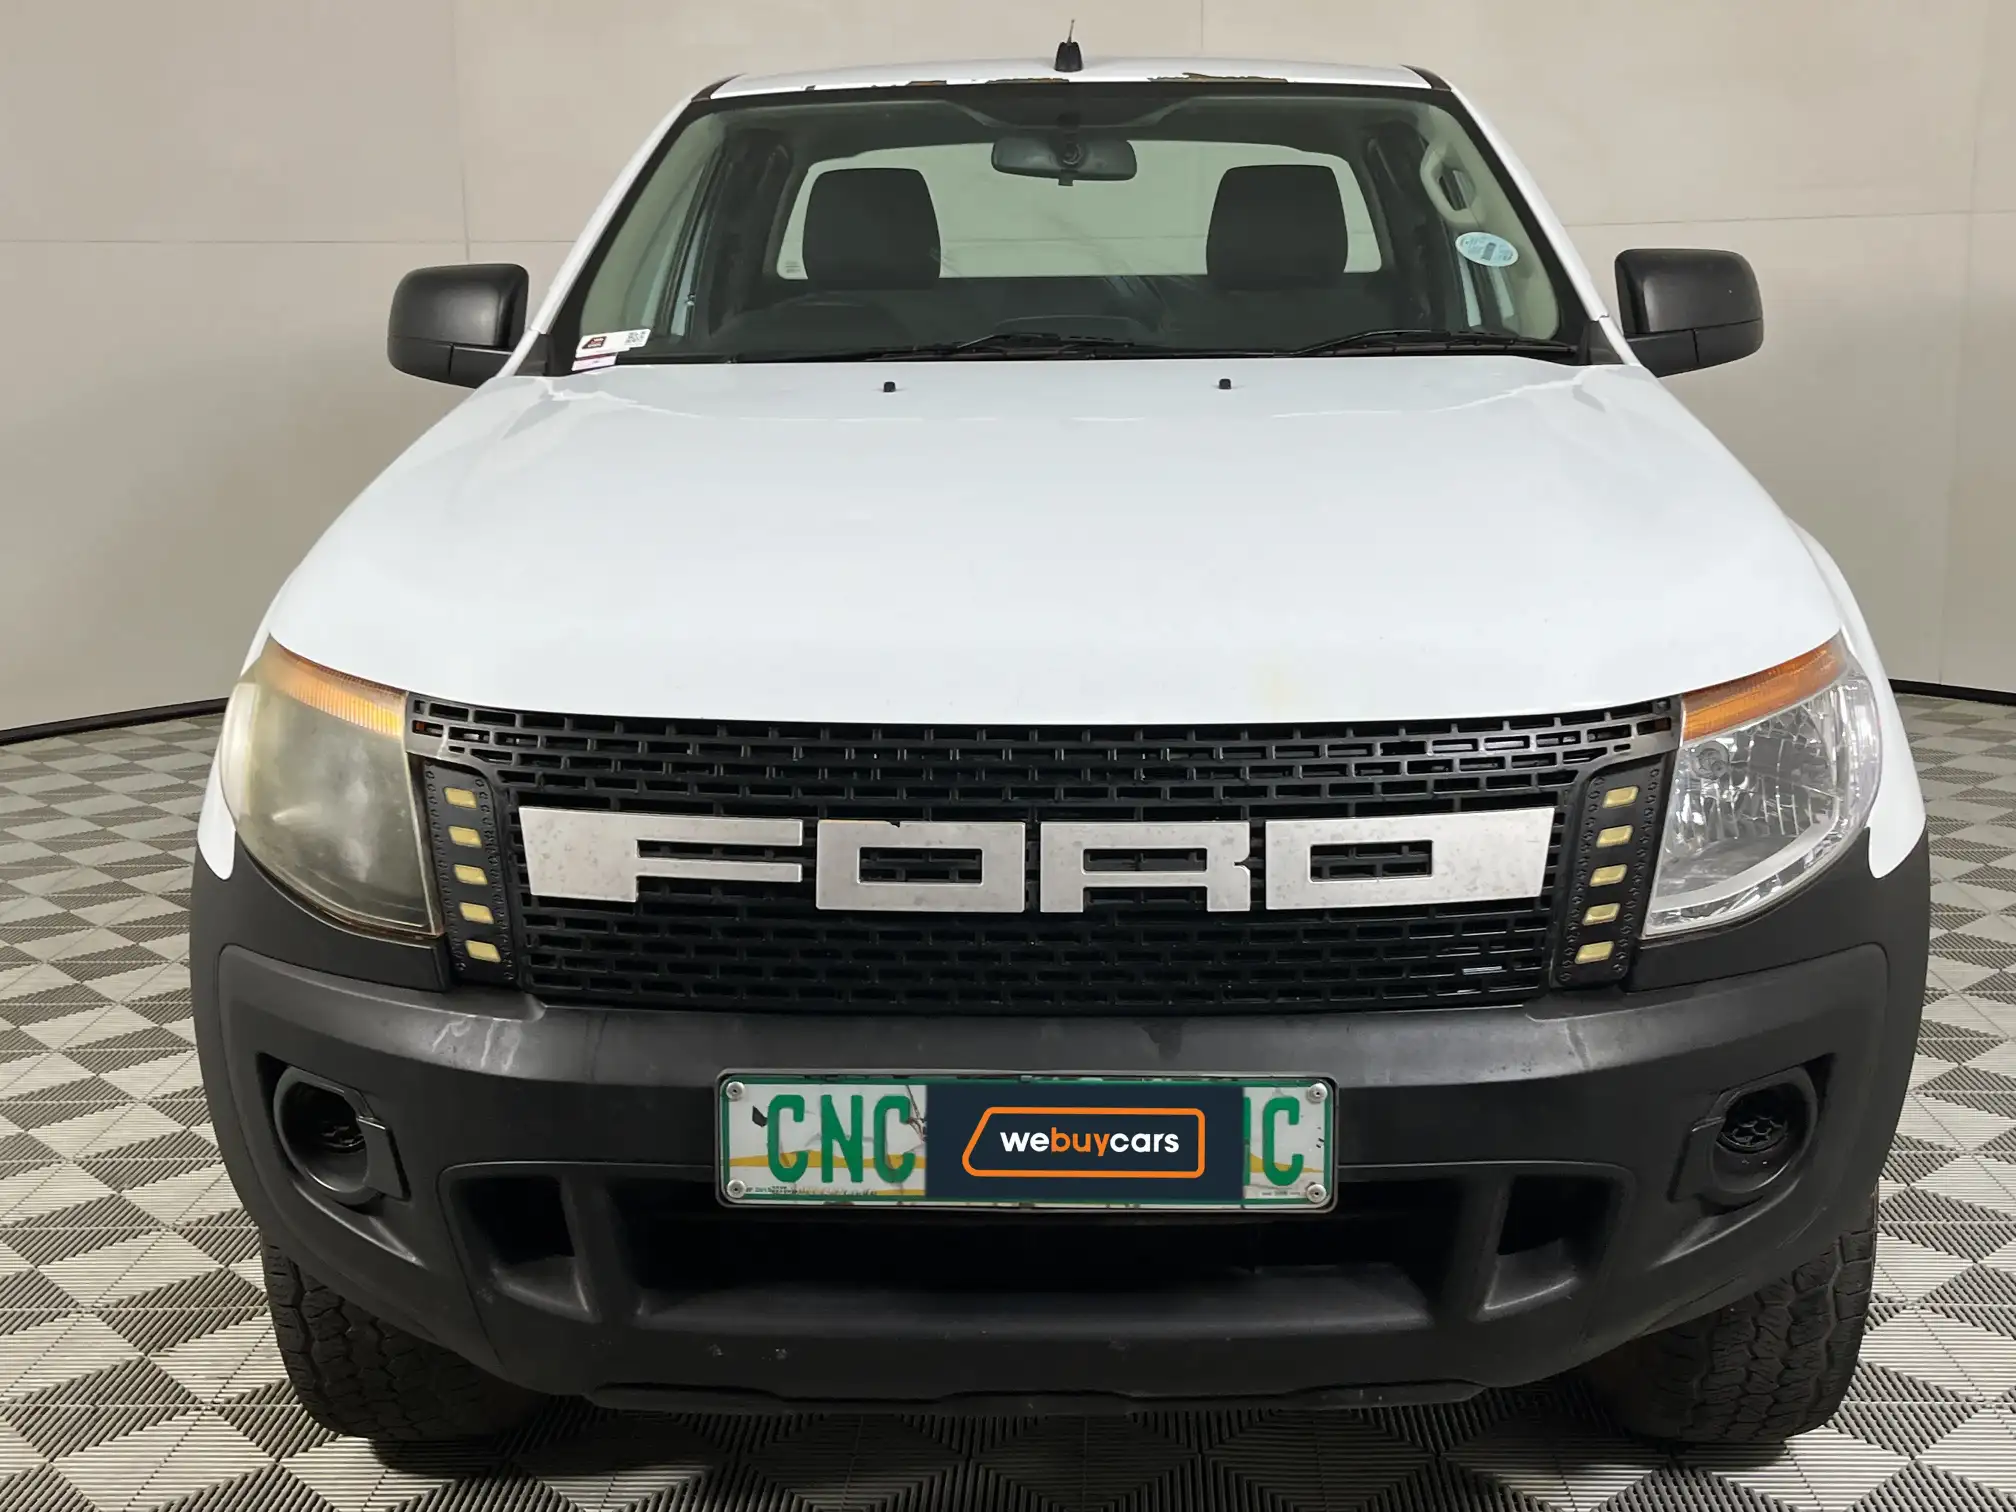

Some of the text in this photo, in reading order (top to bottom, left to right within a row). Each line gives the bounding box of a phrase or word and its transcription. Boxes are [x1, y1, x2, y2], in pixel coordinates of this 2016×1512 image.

[518, 805, 1553, 912] FORD
[767, 1094, 916, 1184] CNC
[1243, 1096, 1304, 1187] C
